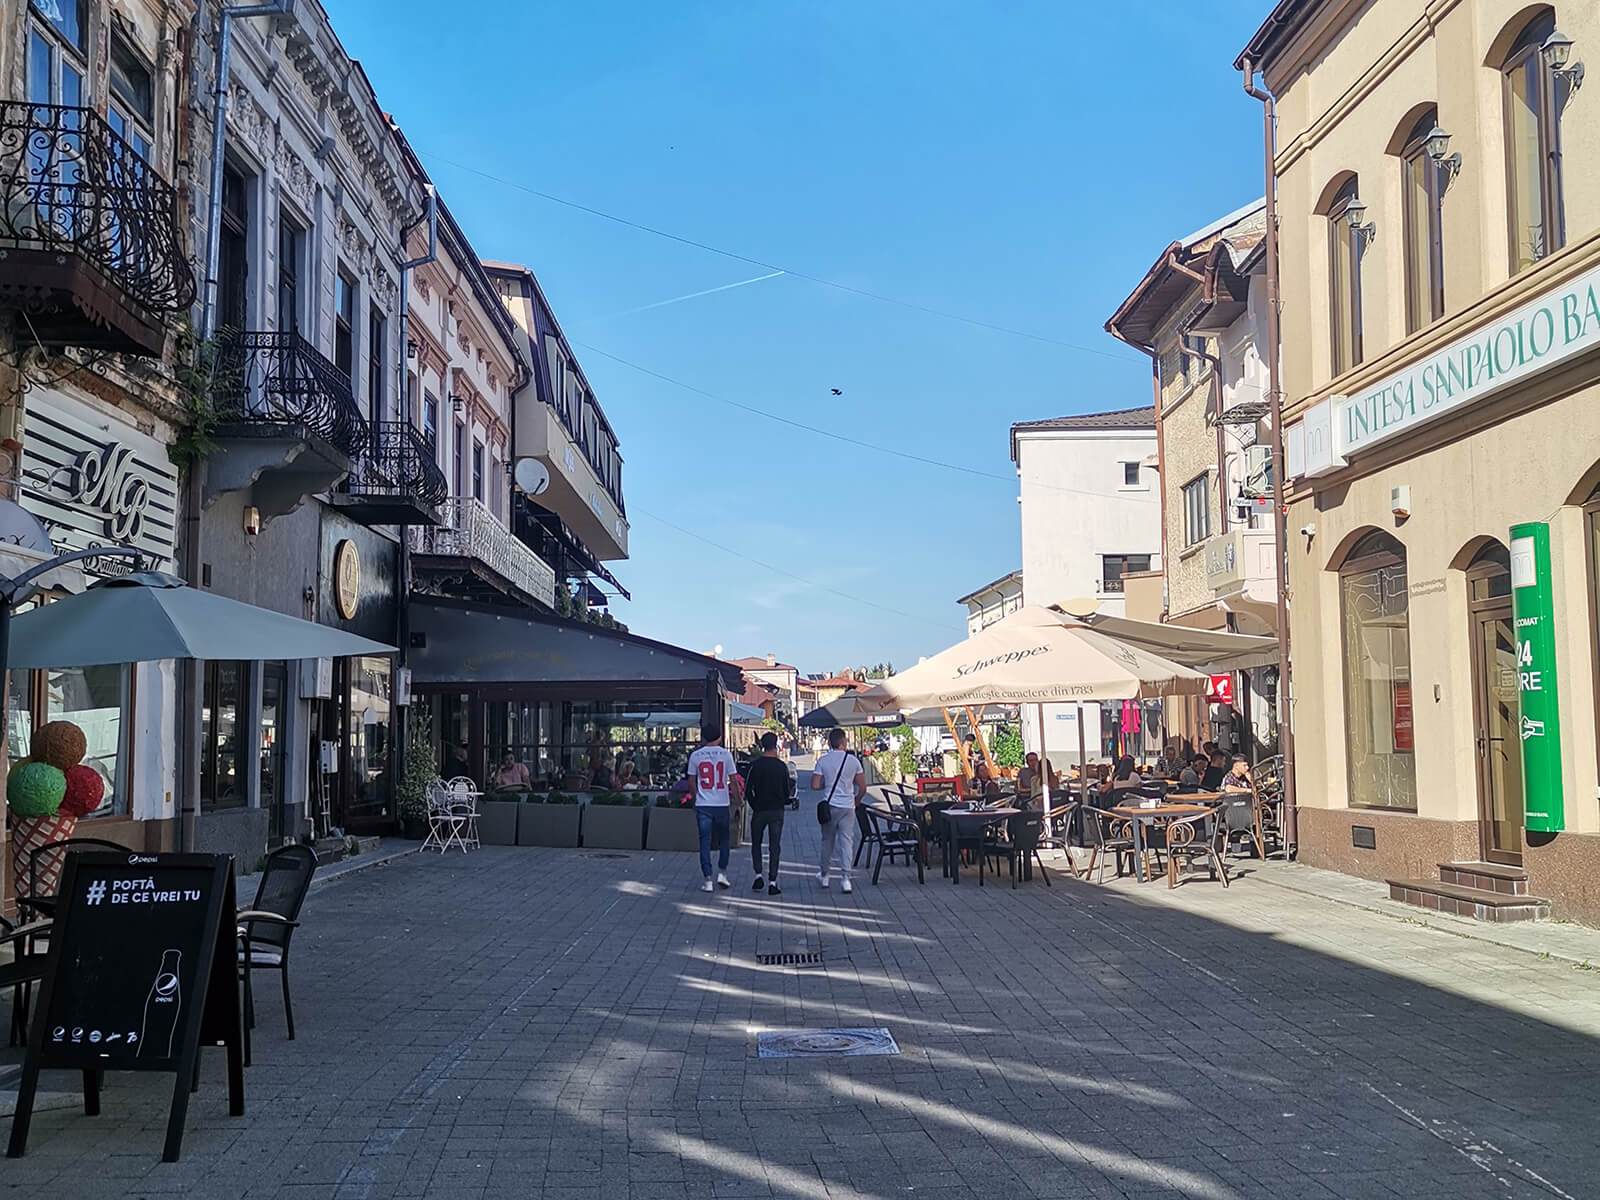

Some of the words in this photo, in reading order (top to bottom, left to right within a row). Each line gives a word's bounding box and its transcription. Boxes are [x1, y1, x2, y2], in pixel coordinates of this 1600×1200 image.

[1347, 375, 1416, 443] INTESA
[1422, 306, 1555, 409] SANPAOLO
[952, 642, 1051, 680] Schweppes
[1051, 686, 1068, 697] din
[1071, 685, 1094, 696] 1783
[1517, 671, 1543, 692] RE
[698, 760, 725, 790] 91
[112, 893, 128, 903] DE
[132, 892, 149, 902] CE
[153, 891, 181, 902] VREI
[184, 890, 200, 901] TU
